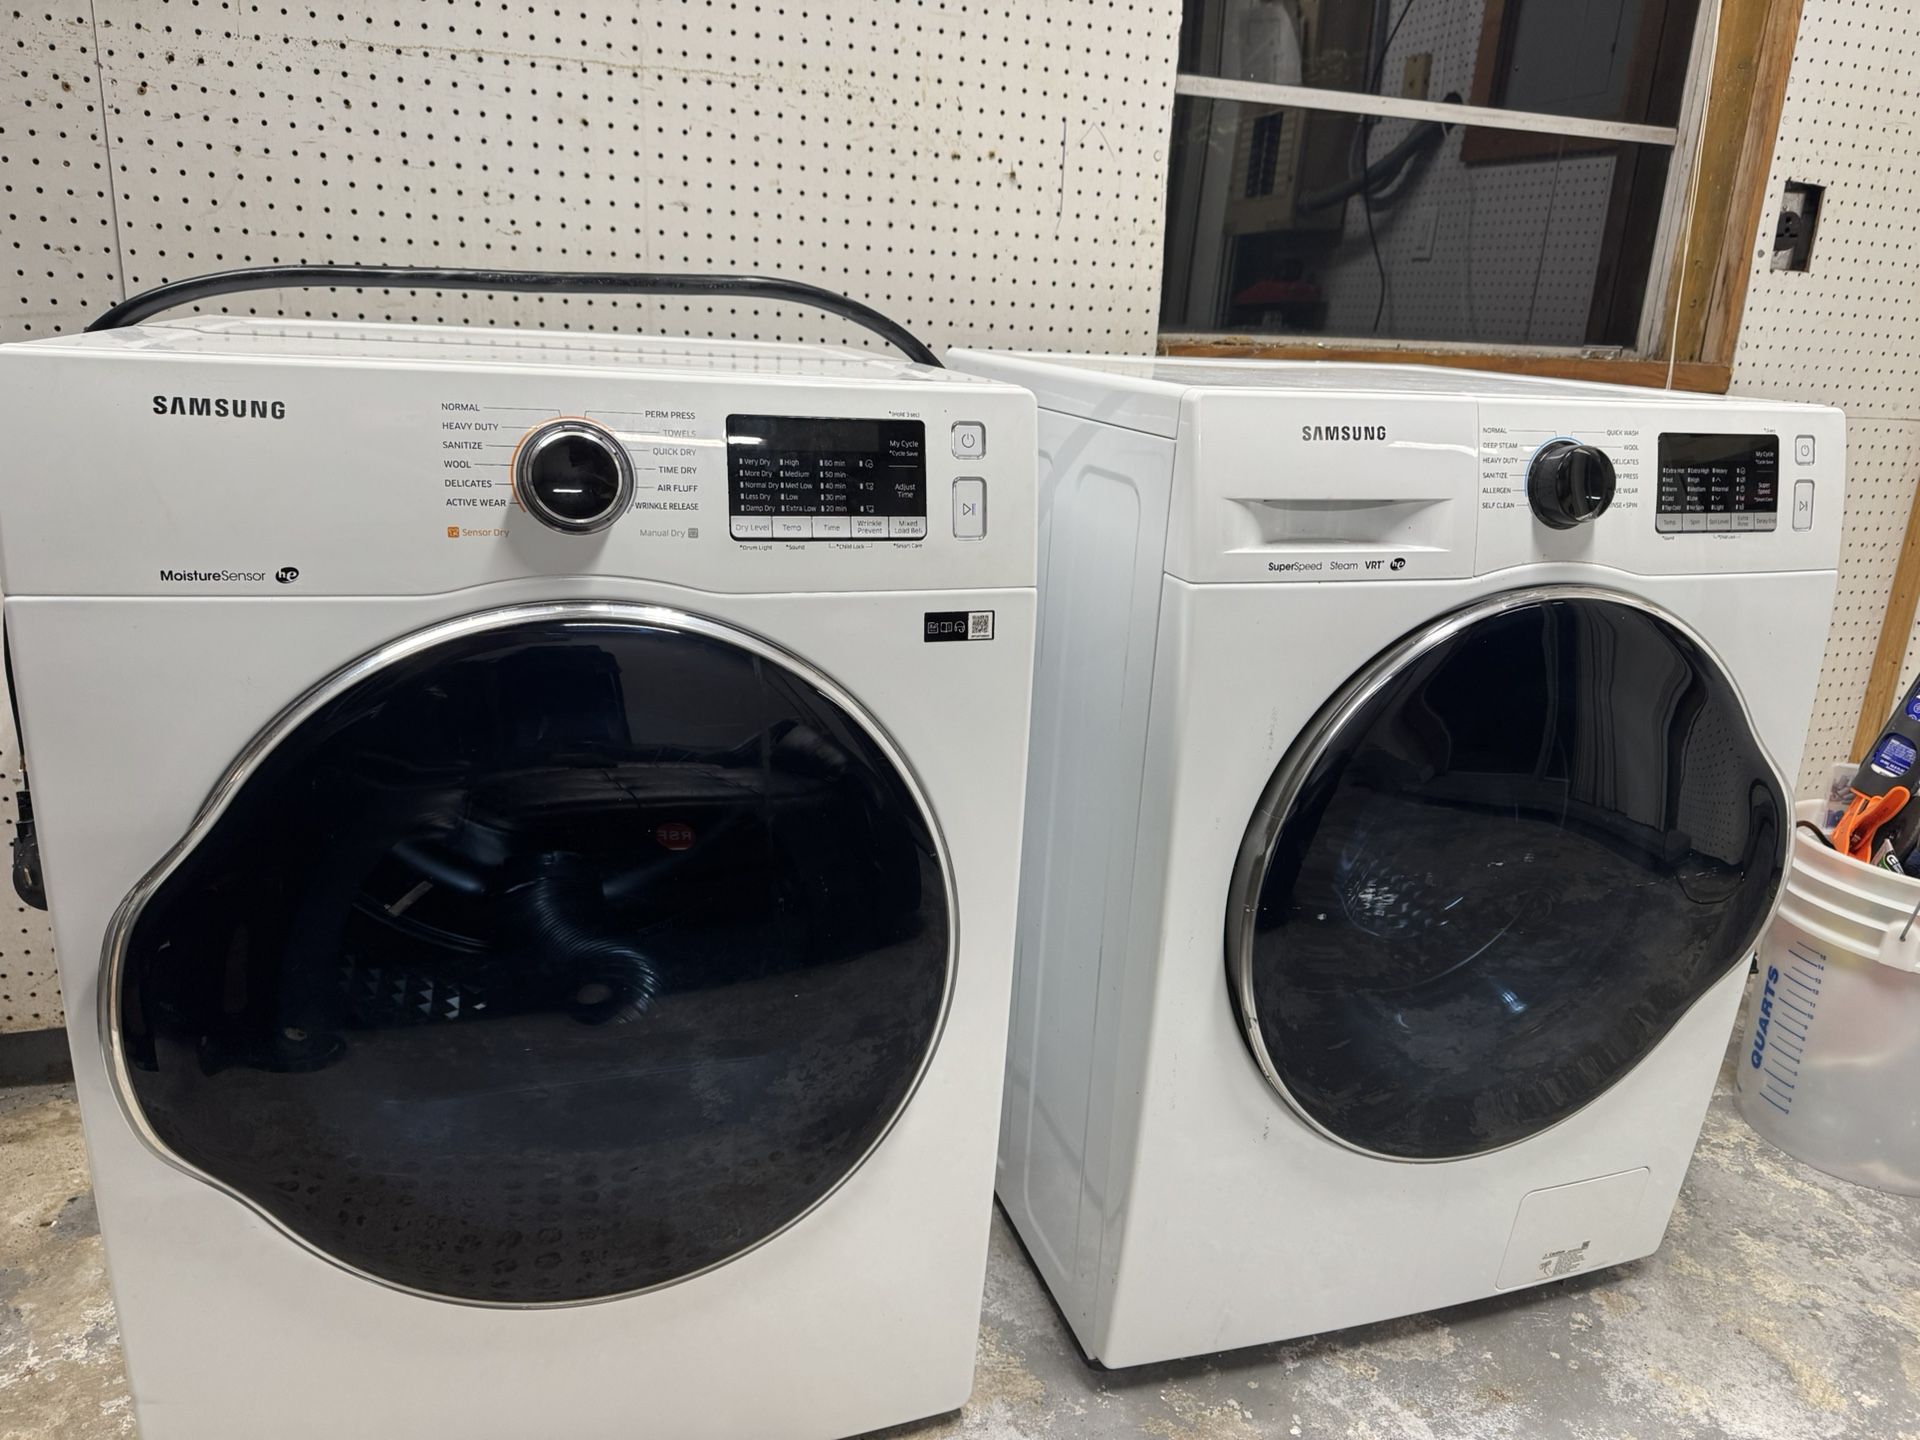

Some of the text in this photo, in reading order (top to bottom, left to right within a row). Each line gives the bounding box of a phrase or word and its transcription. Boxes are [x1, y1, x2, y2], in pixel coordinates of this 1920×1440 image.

[152, 395, 286, 420] SAMSUNG
[441, 403, 480, 412] NORMAL
[645, 410, 696, 420] PERM PRESS
[442, 422, 498, 431] HEAVY DUTY
[663, 429, 697, 438] TOWELS
[1302, 425, 1387, 441] SAMSUNG
[442, 441, 483, 450] SANITIZE
[889, 440, 919, 449] My Cycle
[652, 447, 697, 456] QUICK DRY
[443, 460, 472, 469] WOOL
[744, 458, 771, 467] Very Dry
[784, 459, 800, 467] High
[824, 459, 845, 467] 60 min
[658, 466, 698, 475] TIME DRY
[744, 469, 773, 479] More Dry
[824, 471, 846, 479] 50 min
[444, 480, 492, 488] DELICATES
[657, 484, 699, 492] AIR FLUFF
[745, 481, 780, 490] Normal Dry
[825, 483, 846, 491] 40 min
[894, 483, 916, 493] Adjust
[760, 493, 771, 501] Dry
[785, 493, 799, 501] Low
[825, 494, 846, 502] 30 min
[897, 491, 914, 499] Time
[446, 499, 506, 507] ACTIVE WEAR
[635, 502, 700, 511] WRINKLE RELEASE
[746, 504, 776, 513] Damp Dry
[786, 504, 803, 512] Extra
[826, 505, 847, 513] 20 min
[736, 523, 770, 532] Dry Level
[782, 523, 802, 532] Temp
[823, 524, 840, 532] Time
[857, 527, 882, 535] Prevent
[462, 528, 510, 538] Sensor Dry
[639, 529, 686, 539] Manual Dry
[1268, 561, 1323, 573] SuperSpeed
[1330, 561, 1359, 570] Steam
[160, 569, 265, 582] MoistureSensor
[1751, 965, 1779, 1070] QUARTS
